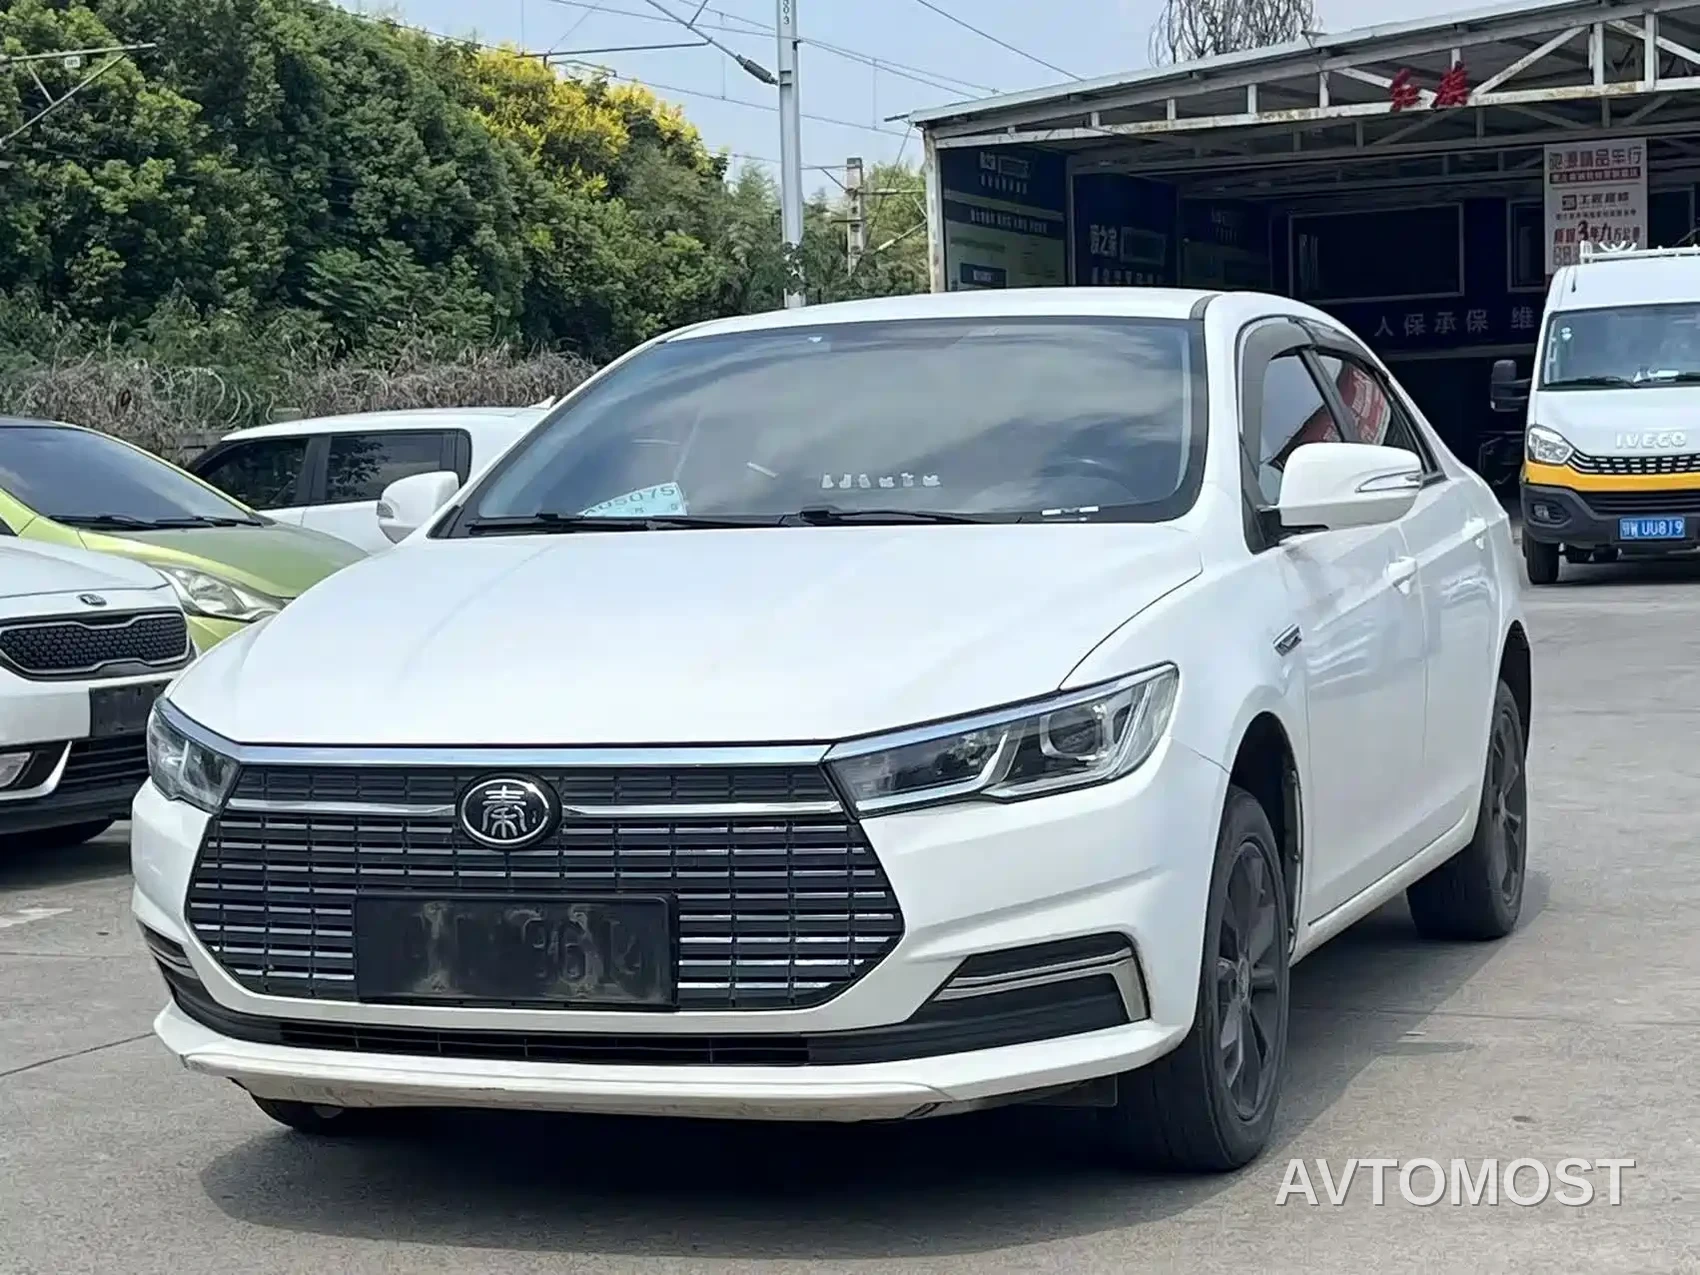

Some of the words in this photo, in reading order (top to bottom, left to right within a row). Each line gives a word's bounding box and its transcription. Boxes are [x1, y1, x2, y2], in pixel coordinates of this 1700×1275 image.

[1374, 308, 1489, 337] 人保承保
[1616, 431, 1687, 449] IVECO
